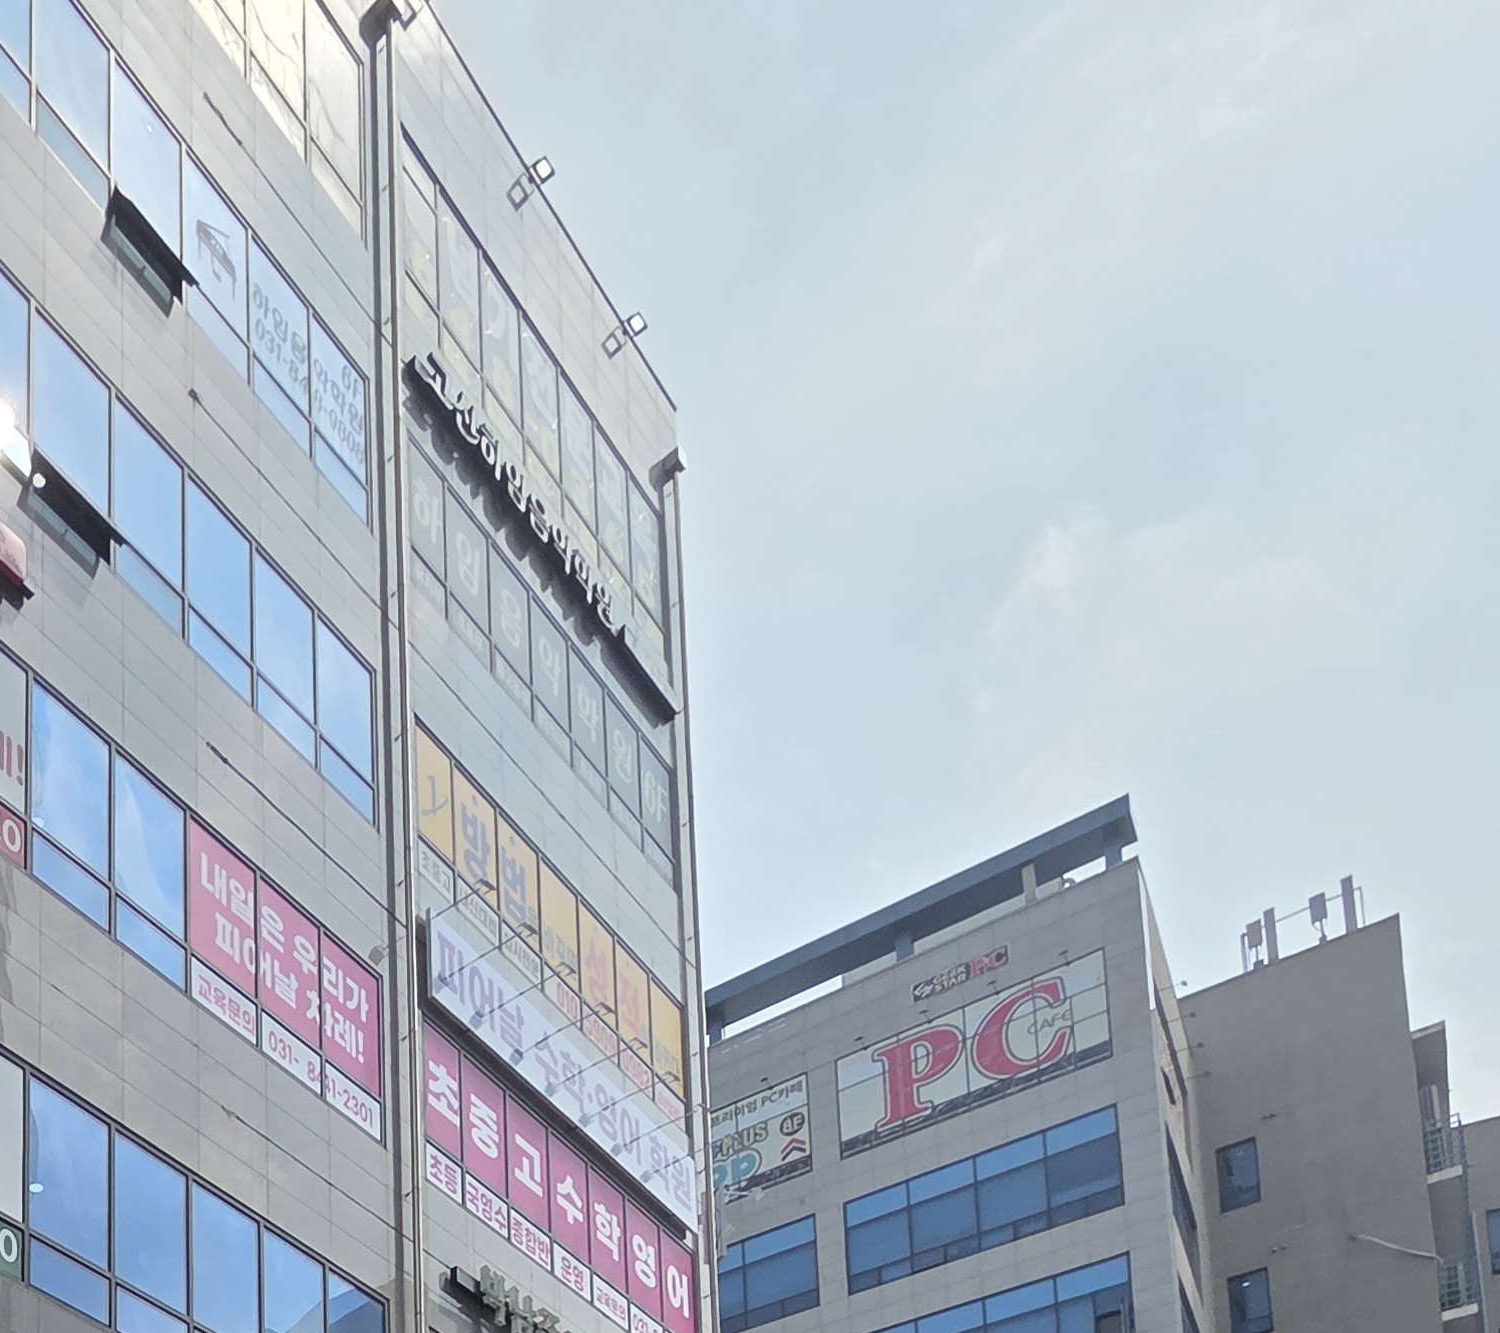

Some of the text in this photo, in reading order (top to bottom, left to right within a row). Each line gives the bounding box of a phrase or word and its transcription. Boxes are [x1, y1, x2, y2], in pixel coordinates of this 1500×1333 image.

[195, 972, 256, 1038] 교육문의
[198, 851, 369, 1020] 내일은 우리가
[215, 917, 366, 1065] 피어날 차례!
[933, 972, 967, 992] STAR
[969, 946, 1008, 982] PC
[437, 930, 525, 1054] 피어날
[649, 1133, 692, 1211] 학원
[872, 976, 1072, 1135] PC
[1026, 1008, 1072, 1036] CAFE
[428, 1151, 458, 1196] 초등
[466, 1181, 508, 1226] 국영수
[510, 1214, 552, 1267] 종합반
[560, 1255, 585, 1292] 운영
[556, 1175, 620, 1262] 수학
[631, 1234, 691, 1319] 영어
